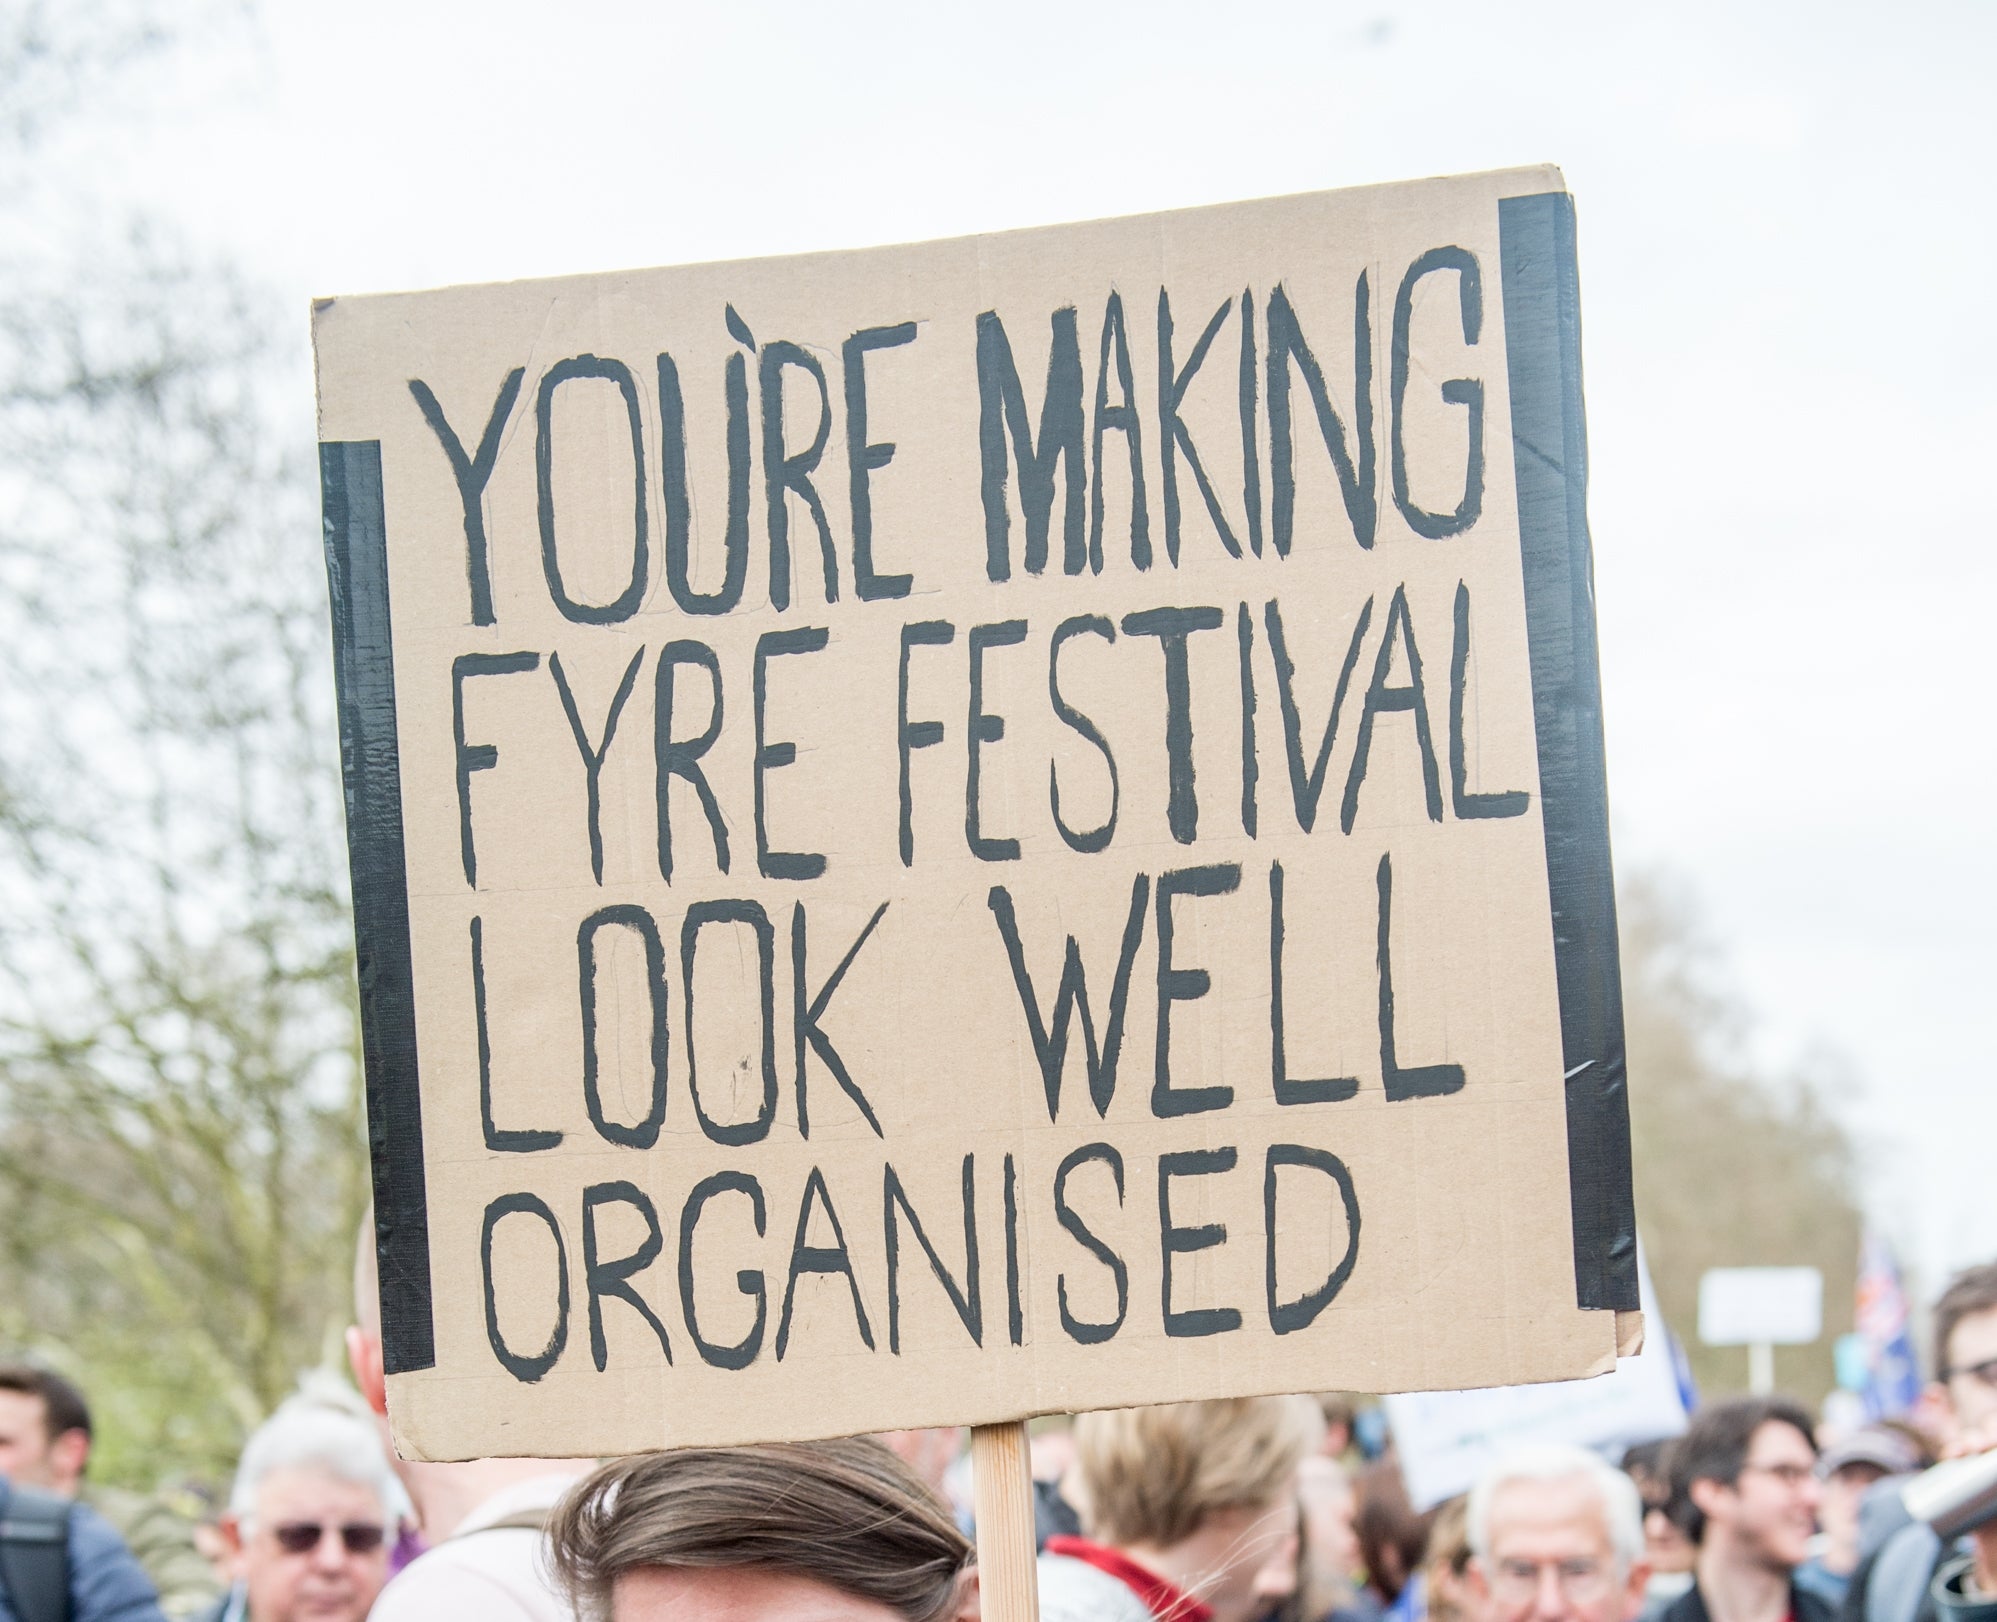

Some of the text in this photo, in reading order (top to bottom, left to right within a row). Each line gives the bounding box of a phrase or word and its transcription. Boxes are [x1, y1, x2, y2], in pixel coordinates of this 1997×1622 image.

[976, 245, 1487, 583] MAKING
[452, 580, 1529, 891] FYRE FESTIVAL
[470, 852, 1467, 1153] LOOK WELL
[481, 1142, 1362, 1385] ORGANISED
